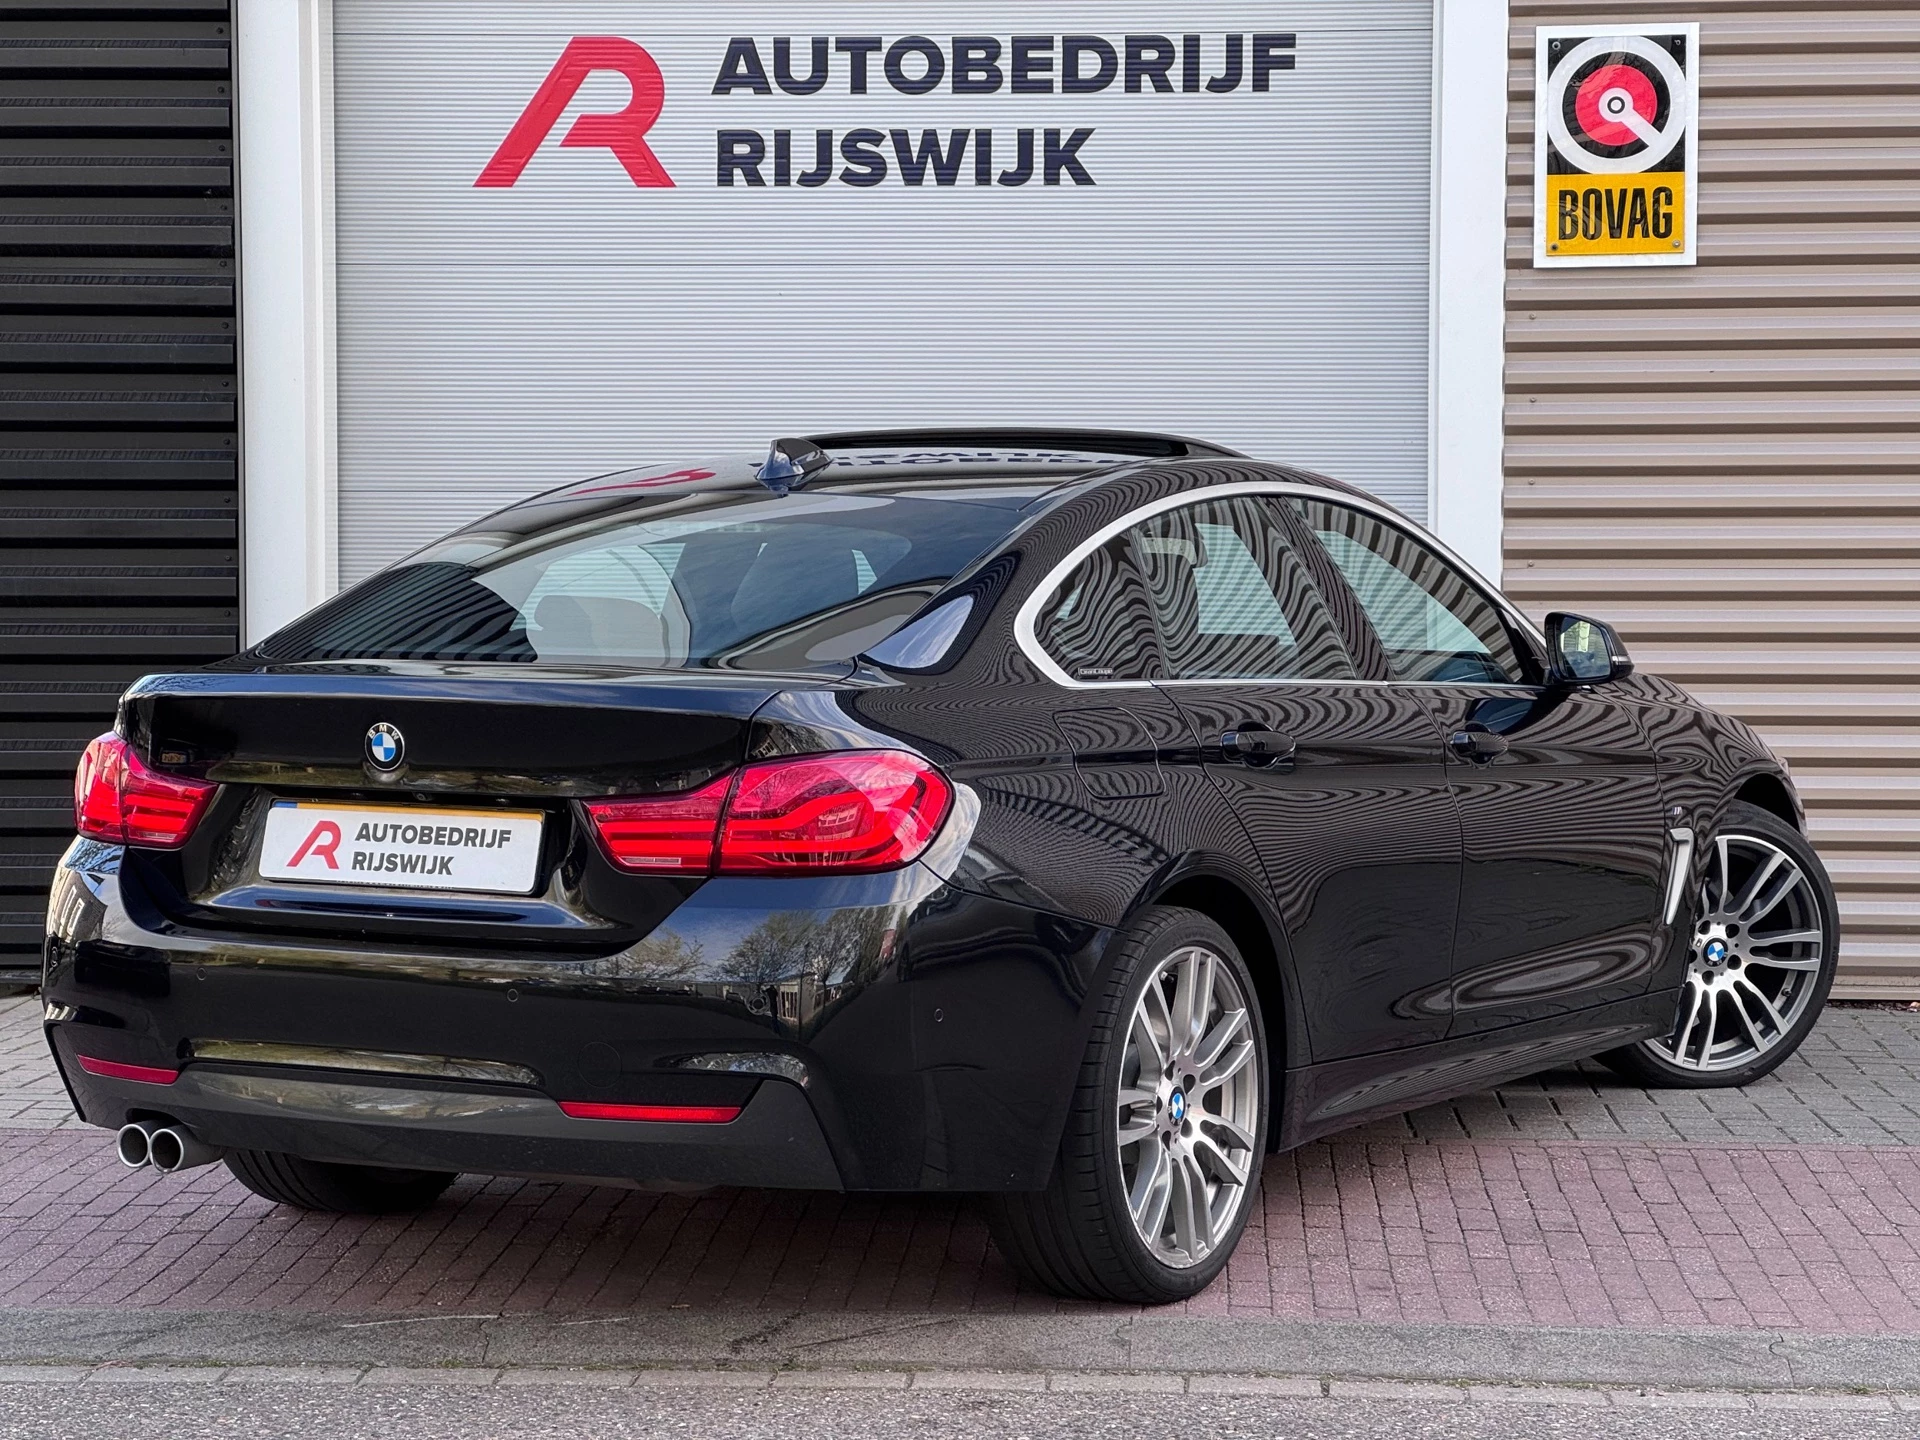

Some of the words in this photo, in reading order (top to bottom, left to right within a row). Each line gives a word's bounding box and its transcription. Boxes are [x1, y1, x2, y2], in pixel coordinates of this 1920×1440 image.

[712, 33, 1297, 95] AUTOBEDRIJF
[717, 128, 1096, 187] RIJSWIJK
[1558, 186, 1673, 240] BOVAG
[368, 724, 400, 740] BMW
[355, 822, 512, 849] AUTOBEDRIJF
[351, 851, 454, 876] RIJSWIJK
